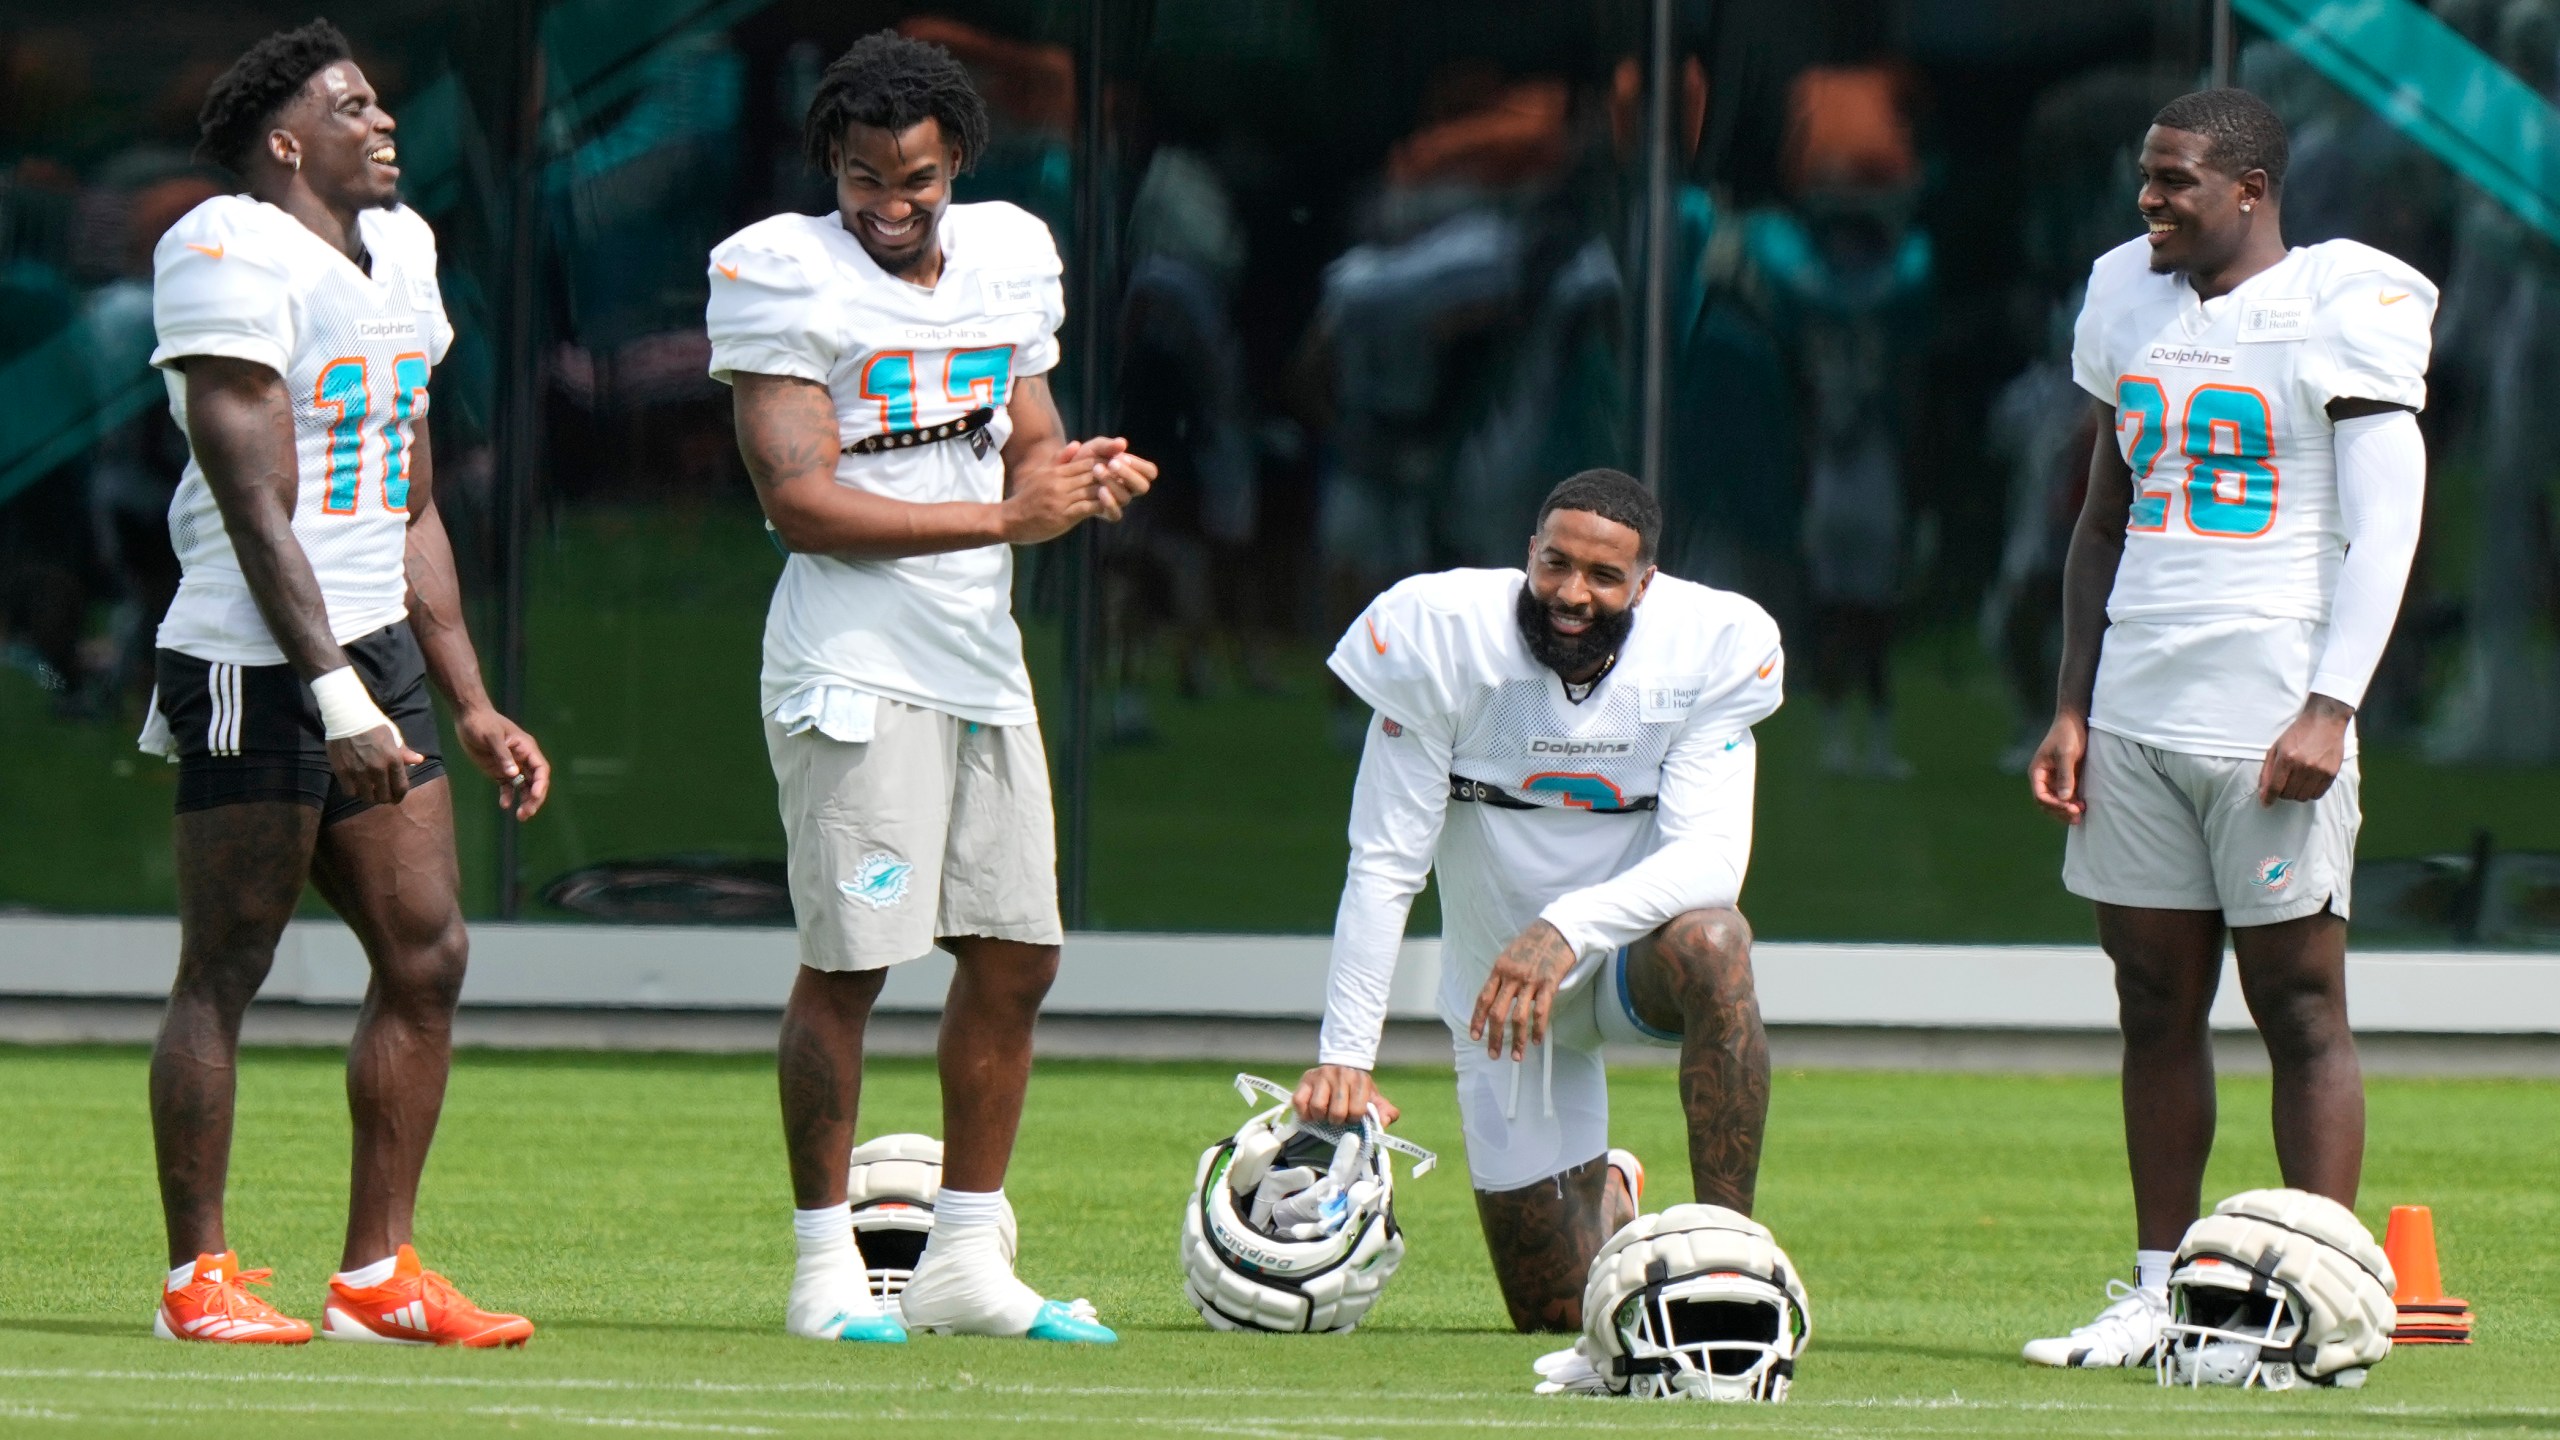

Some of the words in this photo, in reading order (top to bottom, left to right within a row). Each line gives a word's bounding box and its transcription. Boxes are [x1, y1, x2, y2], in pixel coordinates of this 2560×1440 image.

[2270, 309, 2302, 319] Baptist
[361, 321, 416, 338] Dolphins
[2269, 319, 2299, 329] Health
[905, 328, 988, 341] Dolphins
[2151, 347, 2232, 365] Dolphins
[860, 343, 1017, 436] 17
[314, 351, 432, 516] 10
[2115, 374, 2280, 539] 28
[1673, 687, 1701, 699] Baptis
[1673, 699, 1696, 709] Heal
[1531, 740, 1630, 756] Dolphins
